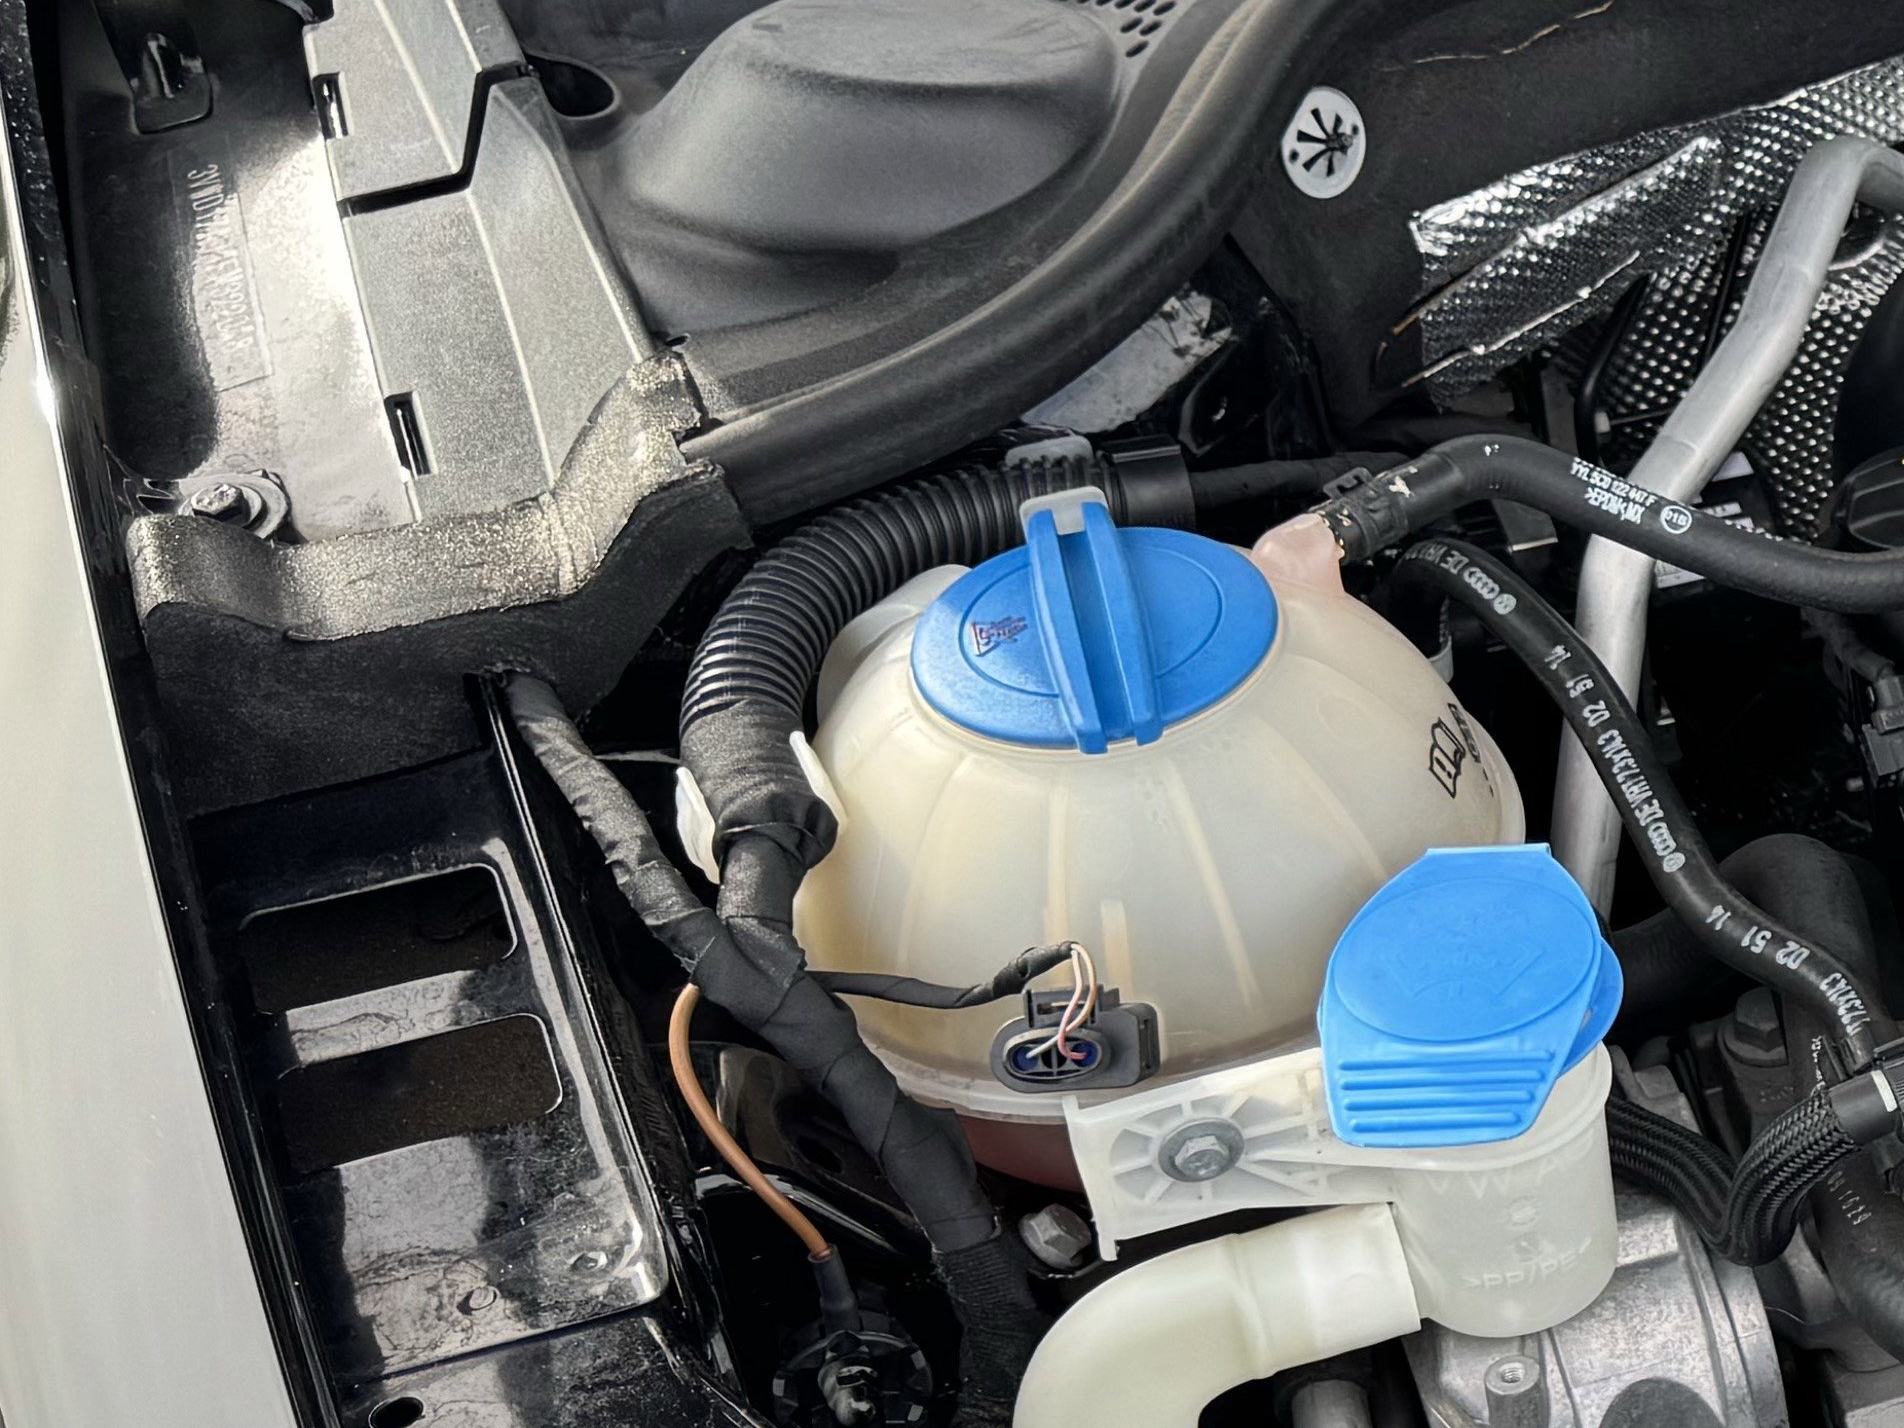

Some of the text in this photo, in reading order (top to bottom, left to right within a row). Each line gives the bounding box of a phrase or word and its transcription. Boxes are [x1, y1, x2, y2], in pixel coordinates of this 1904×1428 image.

[1565, 674, 1595, 699] 51
[1582, 700, 1611, 728] 02
[1741, 925, 1772, 954] 51
[1775, 940, 1811, 970] 02
